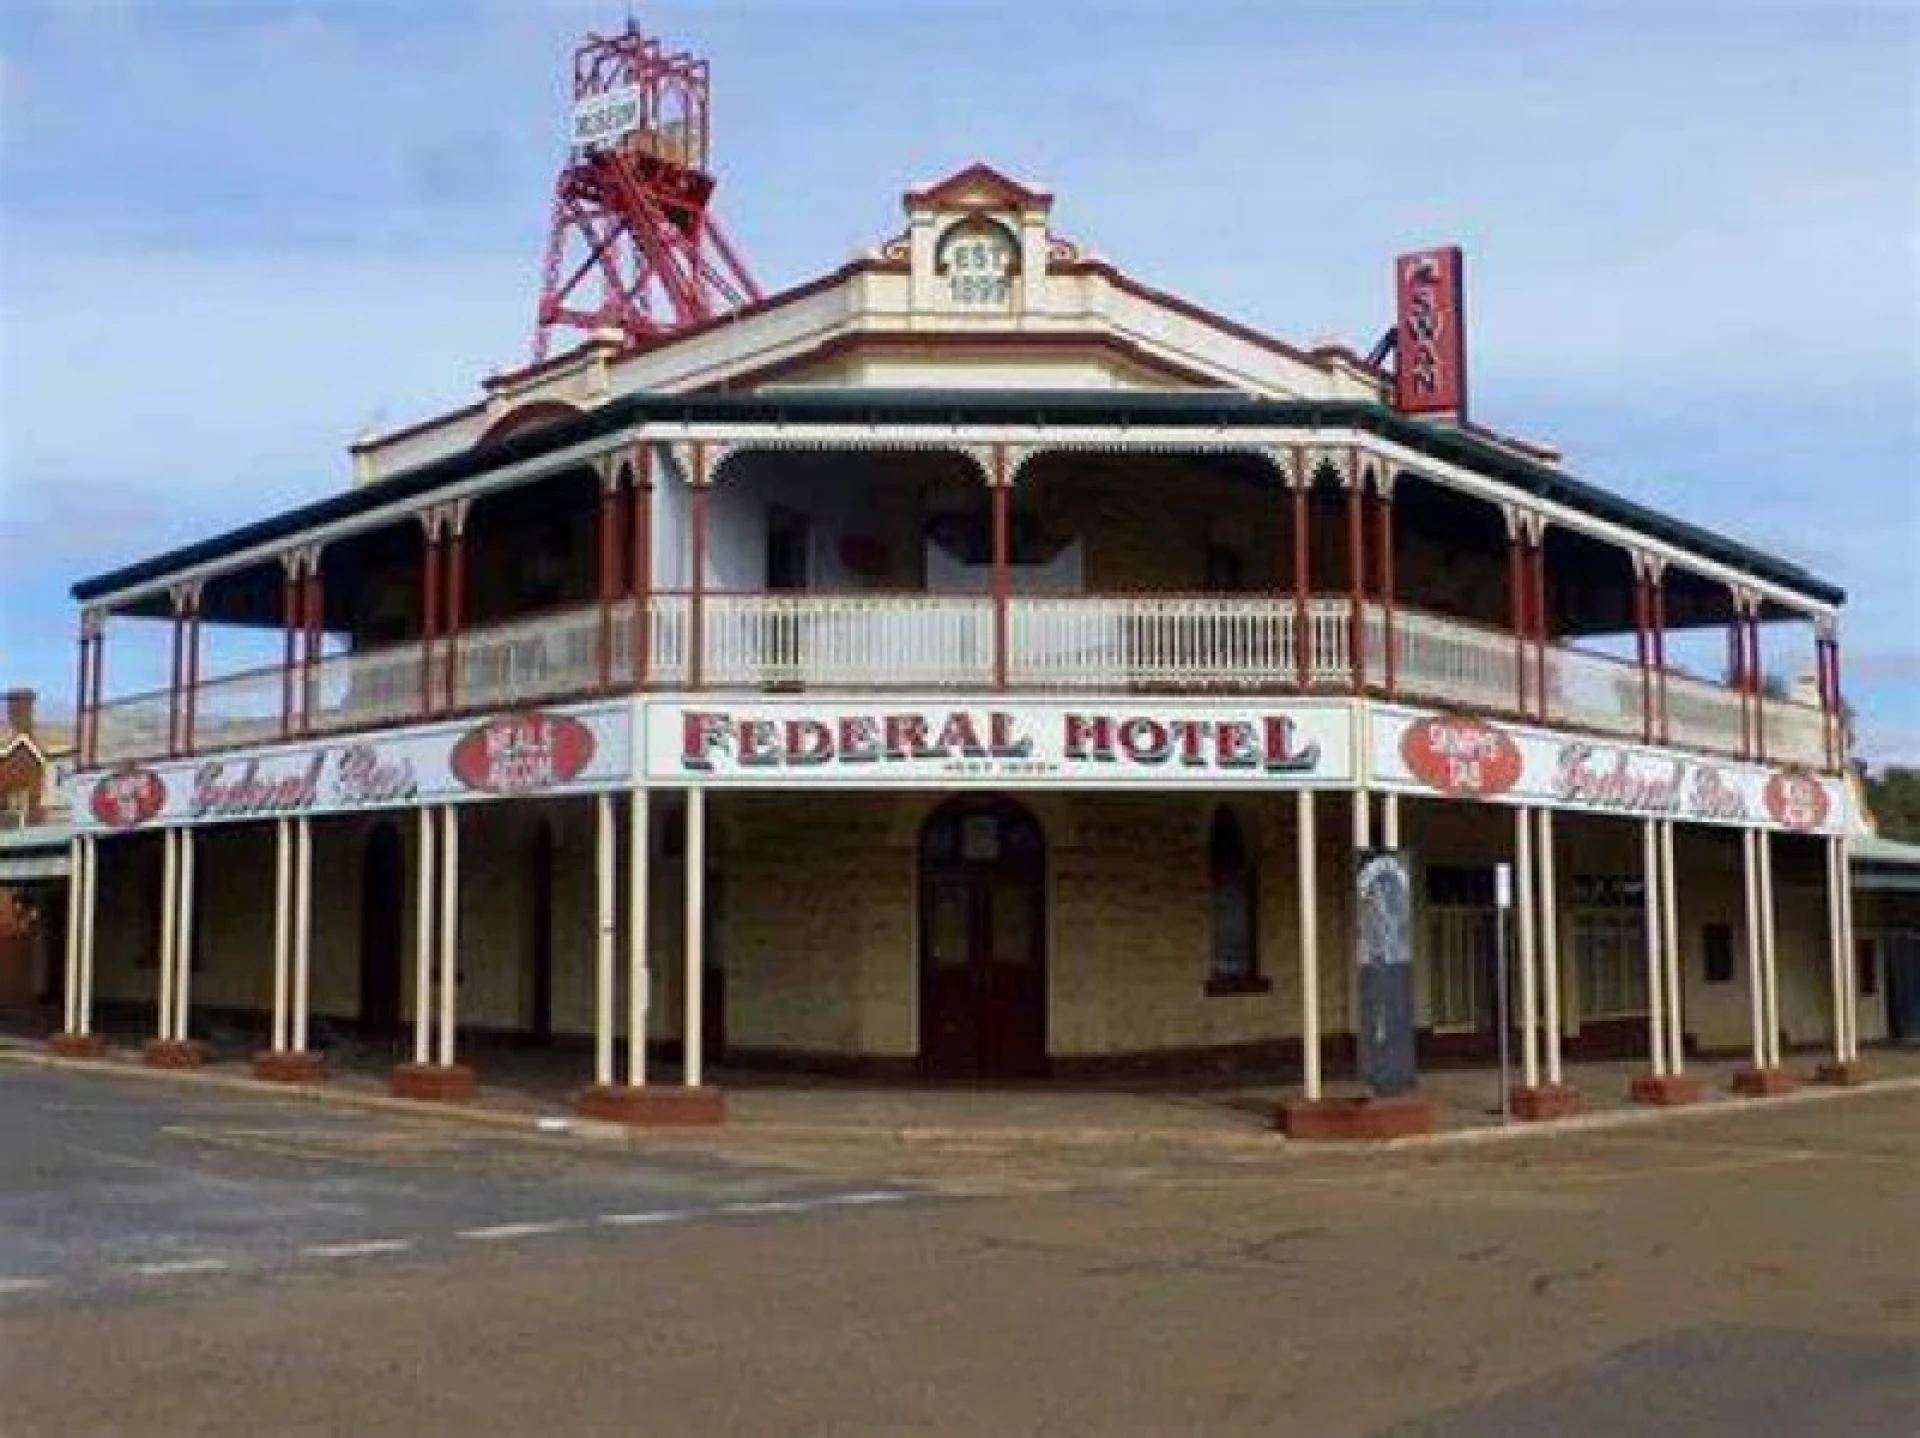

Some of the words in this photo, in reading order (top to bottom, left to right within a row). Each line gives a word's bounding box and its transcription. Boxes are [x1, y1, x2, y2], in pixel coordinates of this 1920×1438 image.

[1405, 287, 1442, 395] SWAN
[681, 709, 1033, 770] FEDERAL
[1063, 711, 1321, 774] HOTEL
